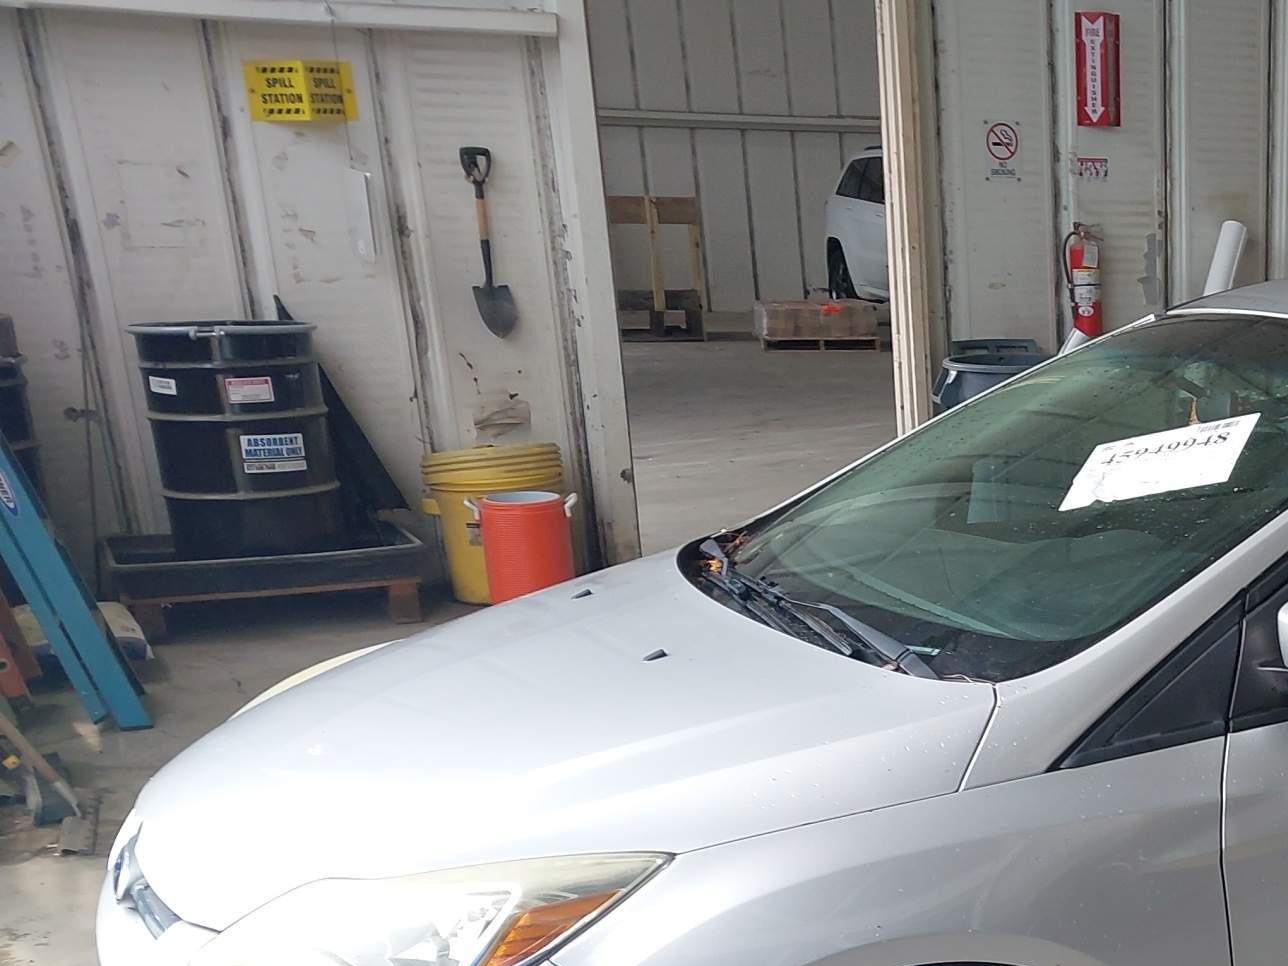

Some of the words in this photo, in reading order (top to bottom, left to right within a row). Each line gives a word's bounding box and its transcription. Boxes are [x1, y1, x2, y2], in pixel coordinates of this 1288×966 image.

[1089, 40, 1098, 114] EXTINGUISHER
[265, 78, 295, 89] SPILL
[312, 78, 337, 89] SPILL
[261, 93, 304, 104] STATION
[247, 436, 299, 448] ABSORBENT
[244, 447, 285, 458] MATERIAL
[1100, 431, 1231, 466] 45949948
